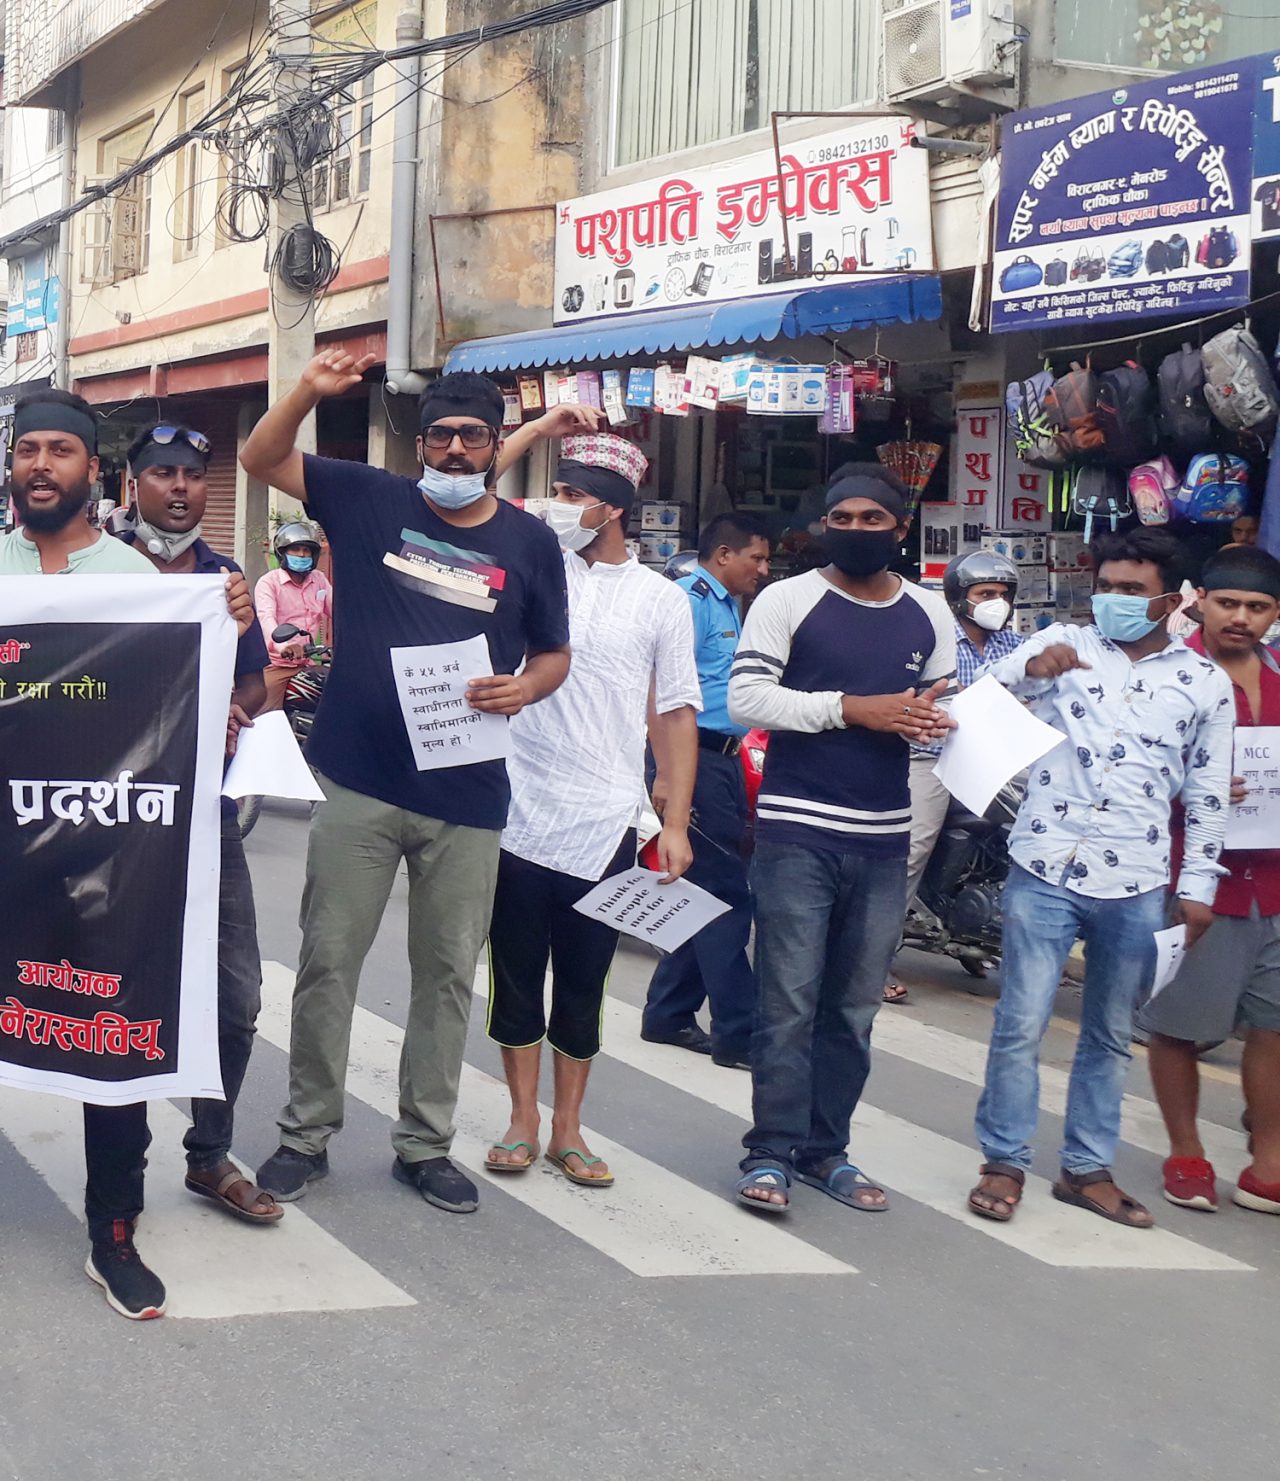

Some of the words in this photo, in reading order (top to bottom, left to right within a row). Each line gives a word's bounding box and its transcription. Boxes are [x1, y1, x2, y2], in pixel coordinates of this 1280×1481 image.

[1121, 107, 1138, 131] र
[818, 135, 889, 162] 9842132130
[574, 179, 705, 268] पशुपति
[716, 149, 898, 242] इम्पेक्स
[714, 241, 752, 257] विराटनगर
[404, 666, 414, 679] के
[419, 666, 435, 678] ५५
[17, 680, 51, 700] रक्षा
[408, 682, 451, 697] नेपालको
[412, 698, 463, 716] स्वाधीनता
[416, 711, 482, 732] स्वाभिमानको
[422, 738, 444, 752] मुल्य
[450, 734, 462, 747] हो
[1244, 747, 1270, 759] MCC
[8, 769, 180, 827] प्रदर्शन
[594, 884, 631, 914] Think
[614, 888, 650, 923] people
[630, 911, 650, 928] not
[646, 895, 665, 911] for
[645, 898, 691, 935] America
[17, 959, 122, 998] आयोजक
